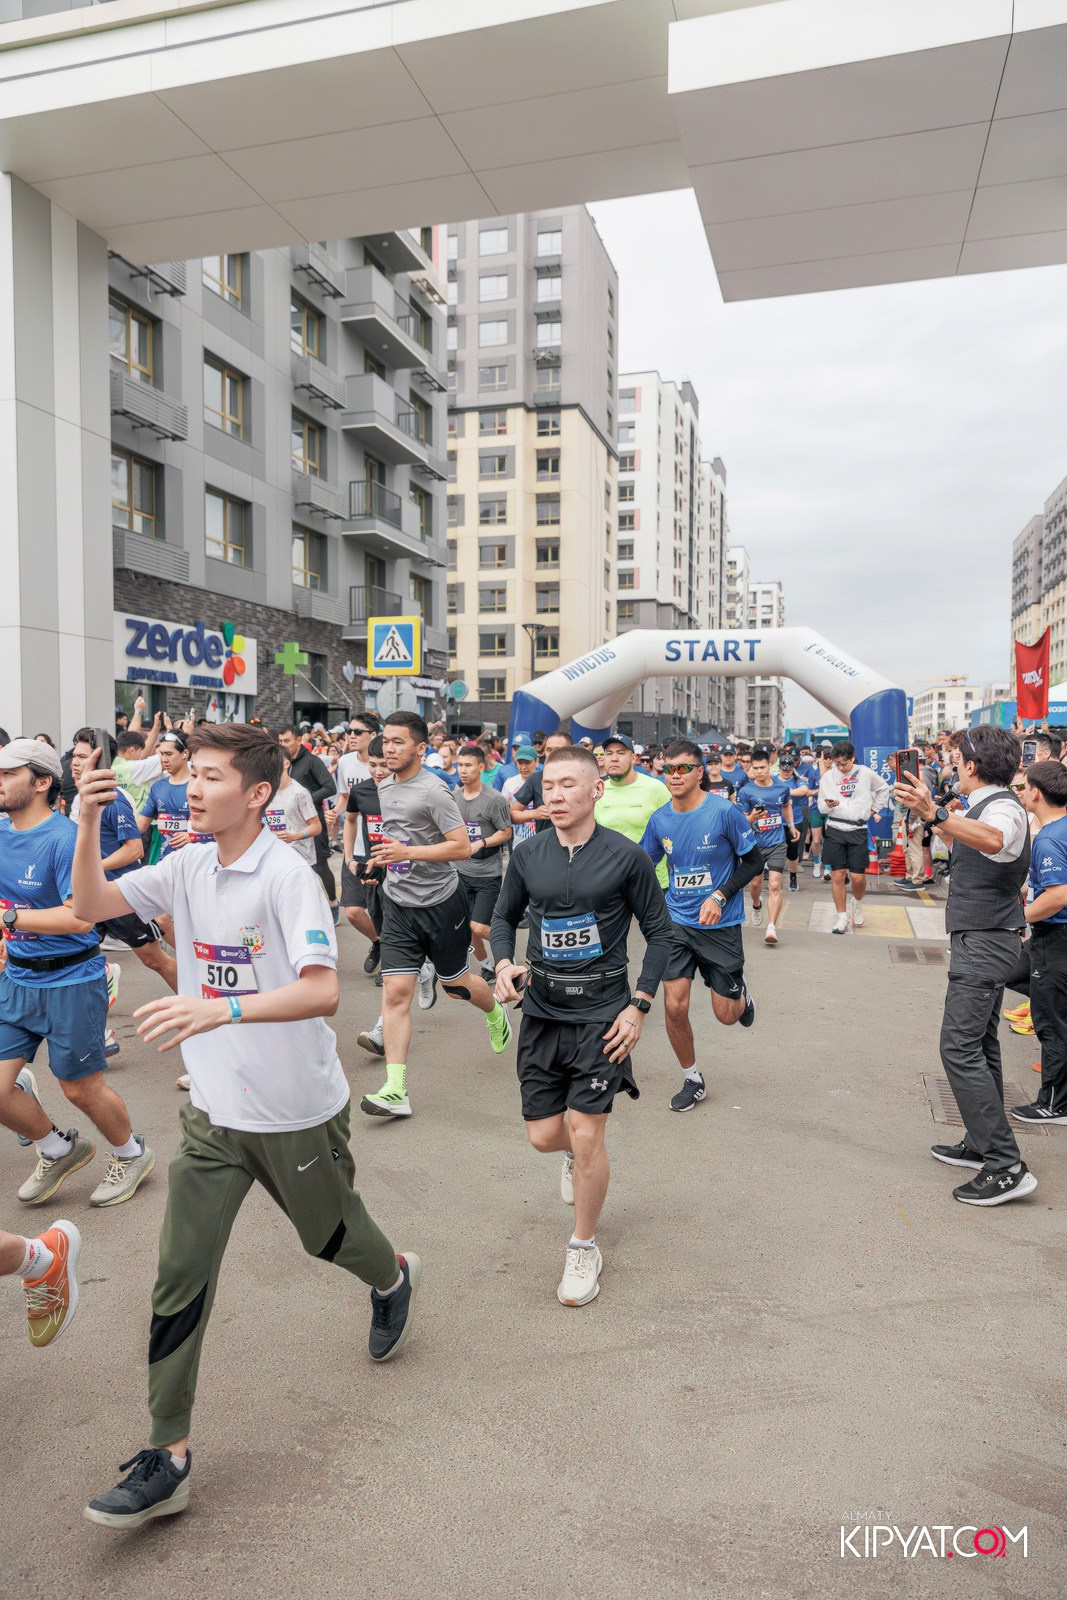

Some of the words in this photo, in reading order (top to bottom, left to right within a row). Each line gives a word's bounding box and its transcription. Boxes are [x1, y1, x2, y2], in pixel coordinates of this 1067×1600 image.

[125, 619, 224, 669] zerde
[665, 639, 762, 662] START
[560, 648, 616, 681] INVICTUS
[840, 783, 856, 791] 069
[164, 821, 180, 830] 178
[676, 874, 706, 888] 1747
[544, 928, 591, 949] 1385
[207, 964, 239, 988] 510
